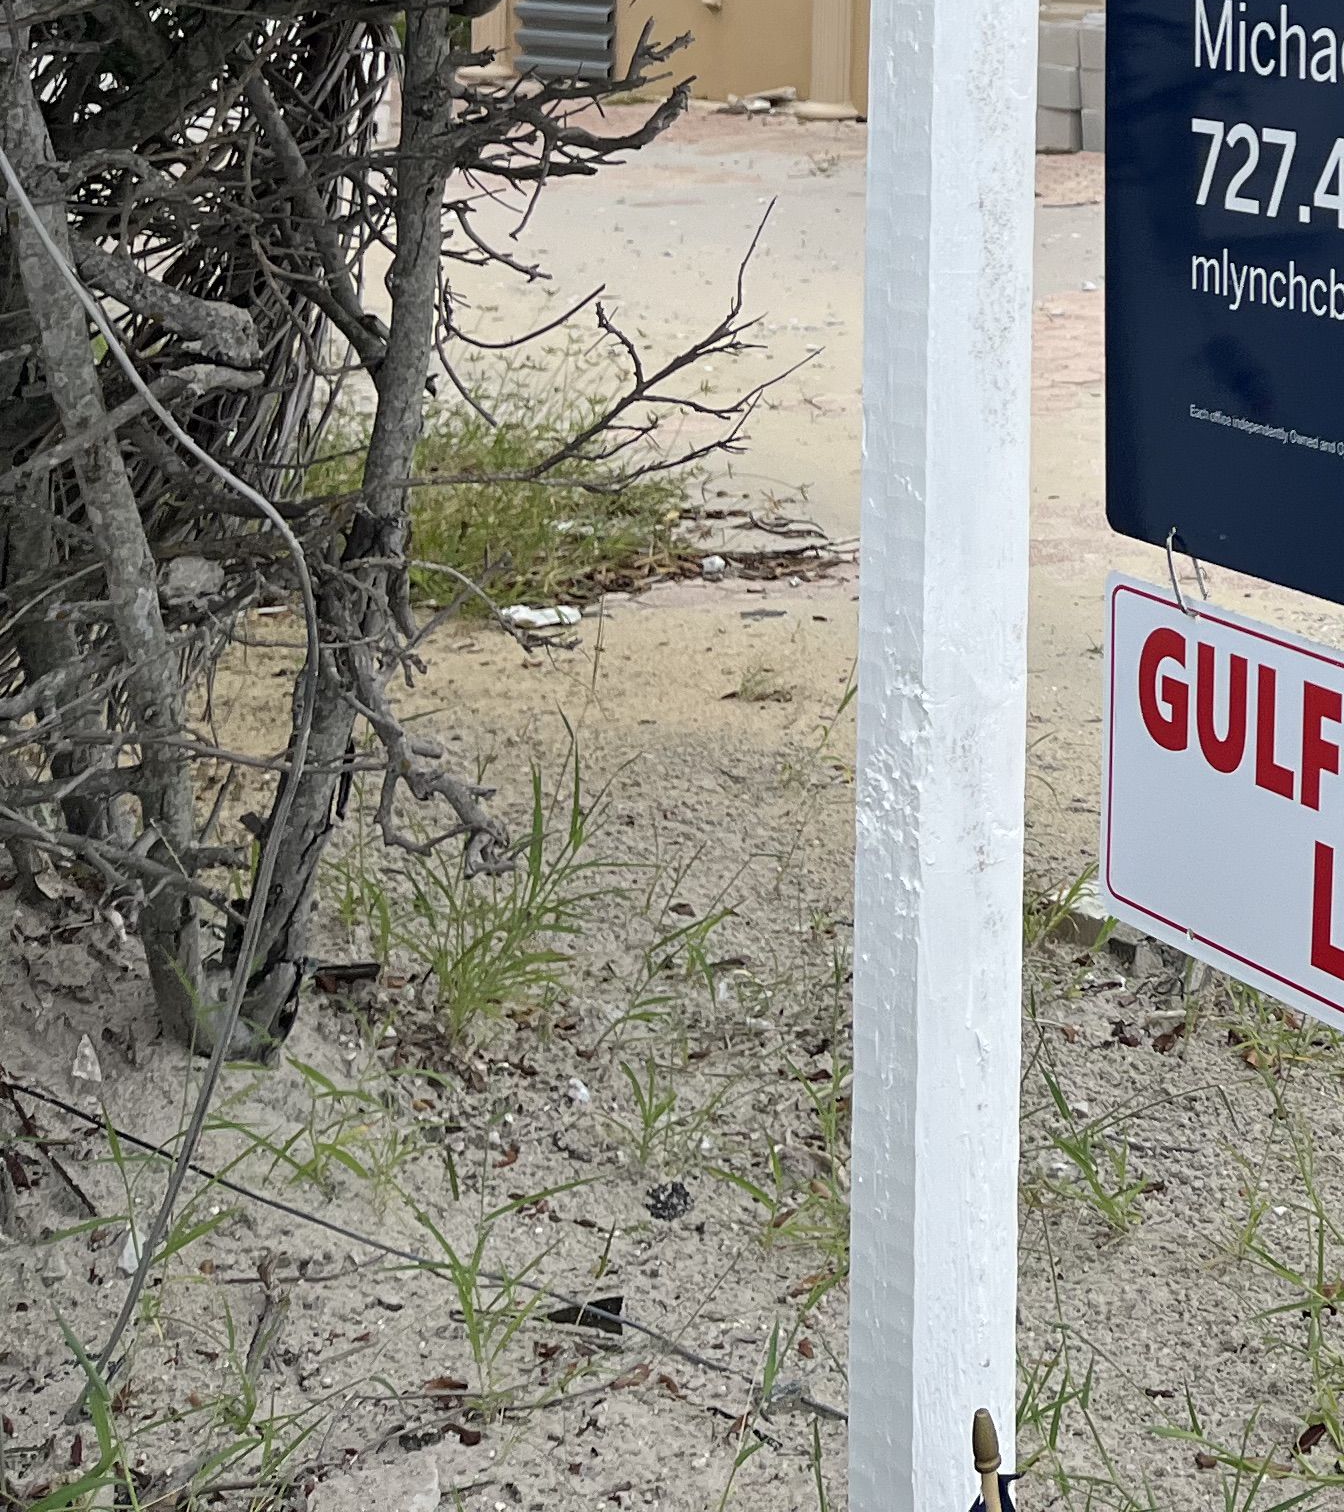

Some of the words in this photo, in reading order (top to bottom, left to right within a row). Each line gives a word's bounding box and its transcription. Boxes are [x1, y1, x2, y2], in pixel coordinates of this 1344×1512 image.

[1189, 403, 1209, 420] Each
[1209, 410, 1232, 427] office
[1289, 429, 1319, 450] Owned
[1319, 440, 1337, 454] and
[1138, 627, 1343, 812] GULF
